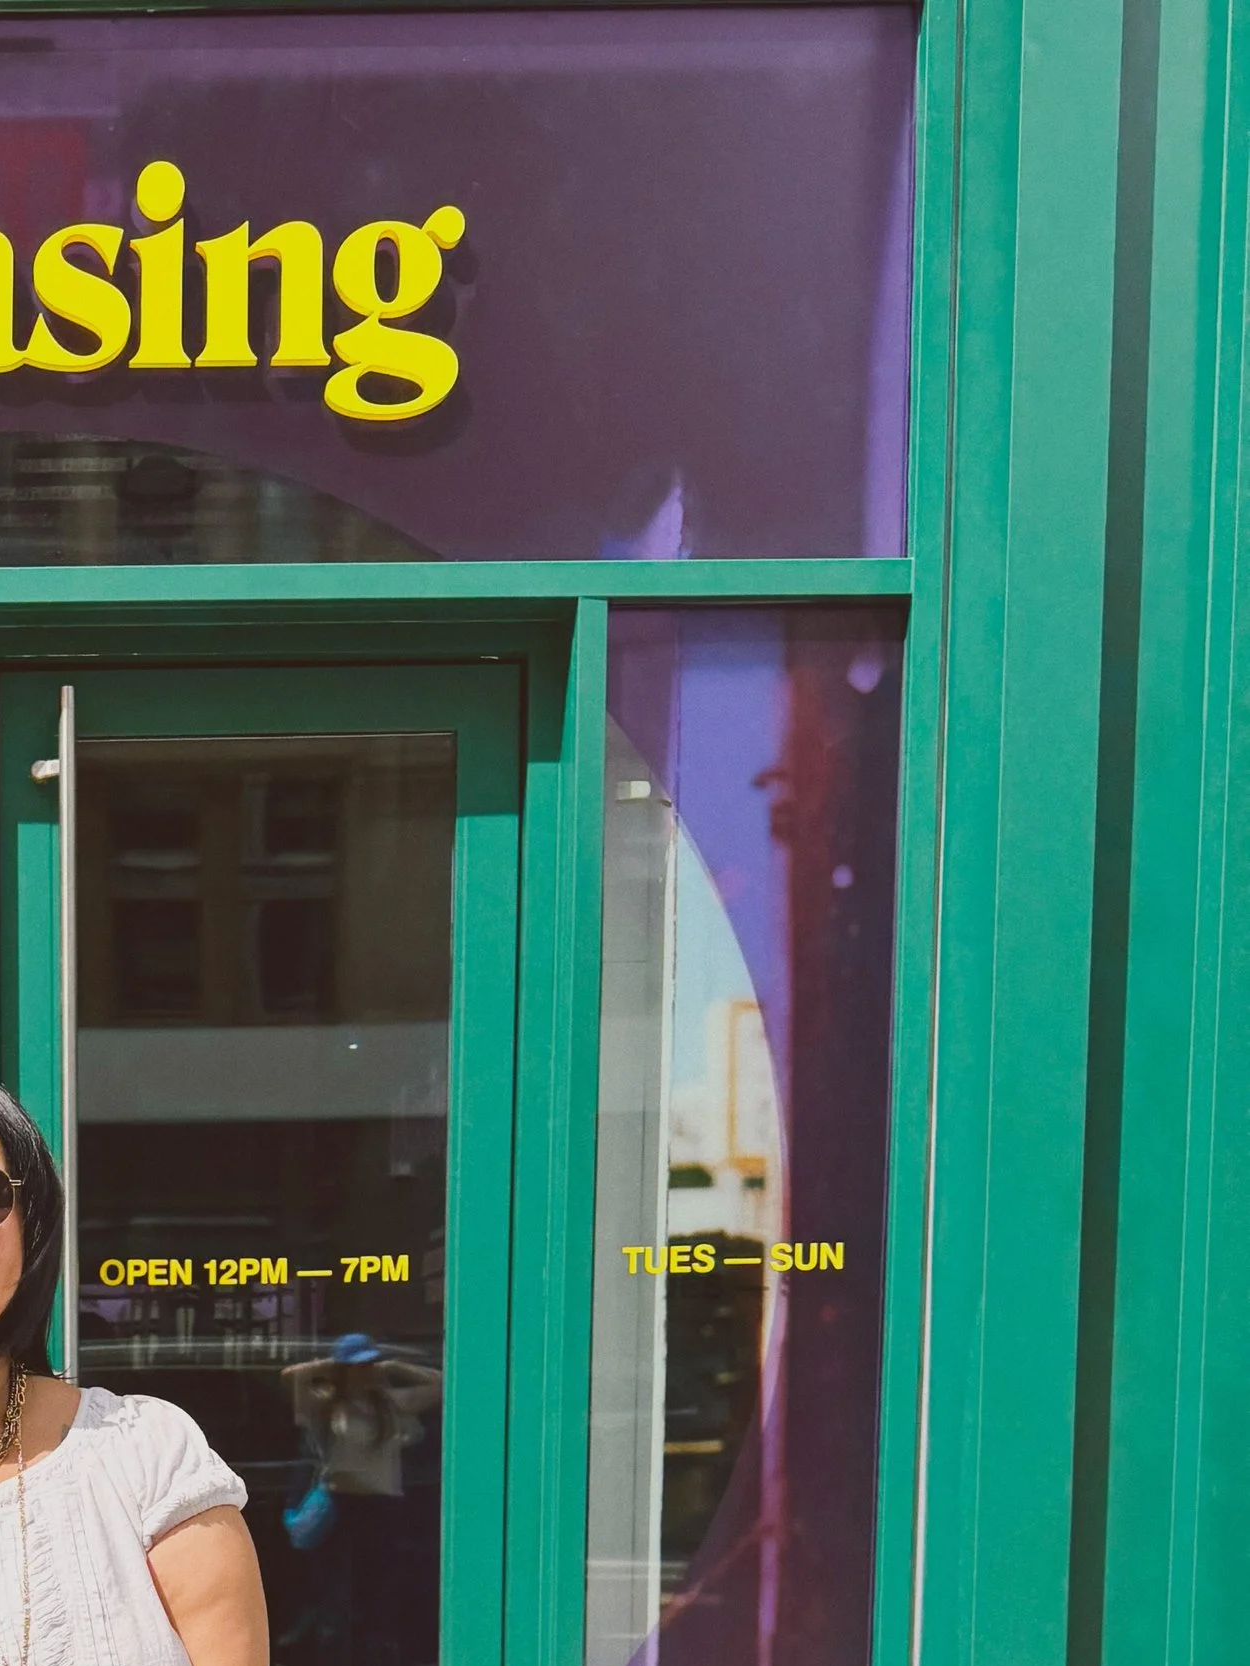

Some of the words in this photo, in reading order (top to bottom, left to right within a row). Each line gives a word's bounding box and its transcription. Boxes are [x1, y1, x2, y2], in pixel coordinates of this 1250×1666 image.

[99, 1258, 193, 1287] OPEN
[203, 1257, 288, 1285] 12PM
[340, 1254, 409, 1284] 7PM
[621, 1244, 716, 1275] TUES
[769, 1242, 845, 1272] SUN
